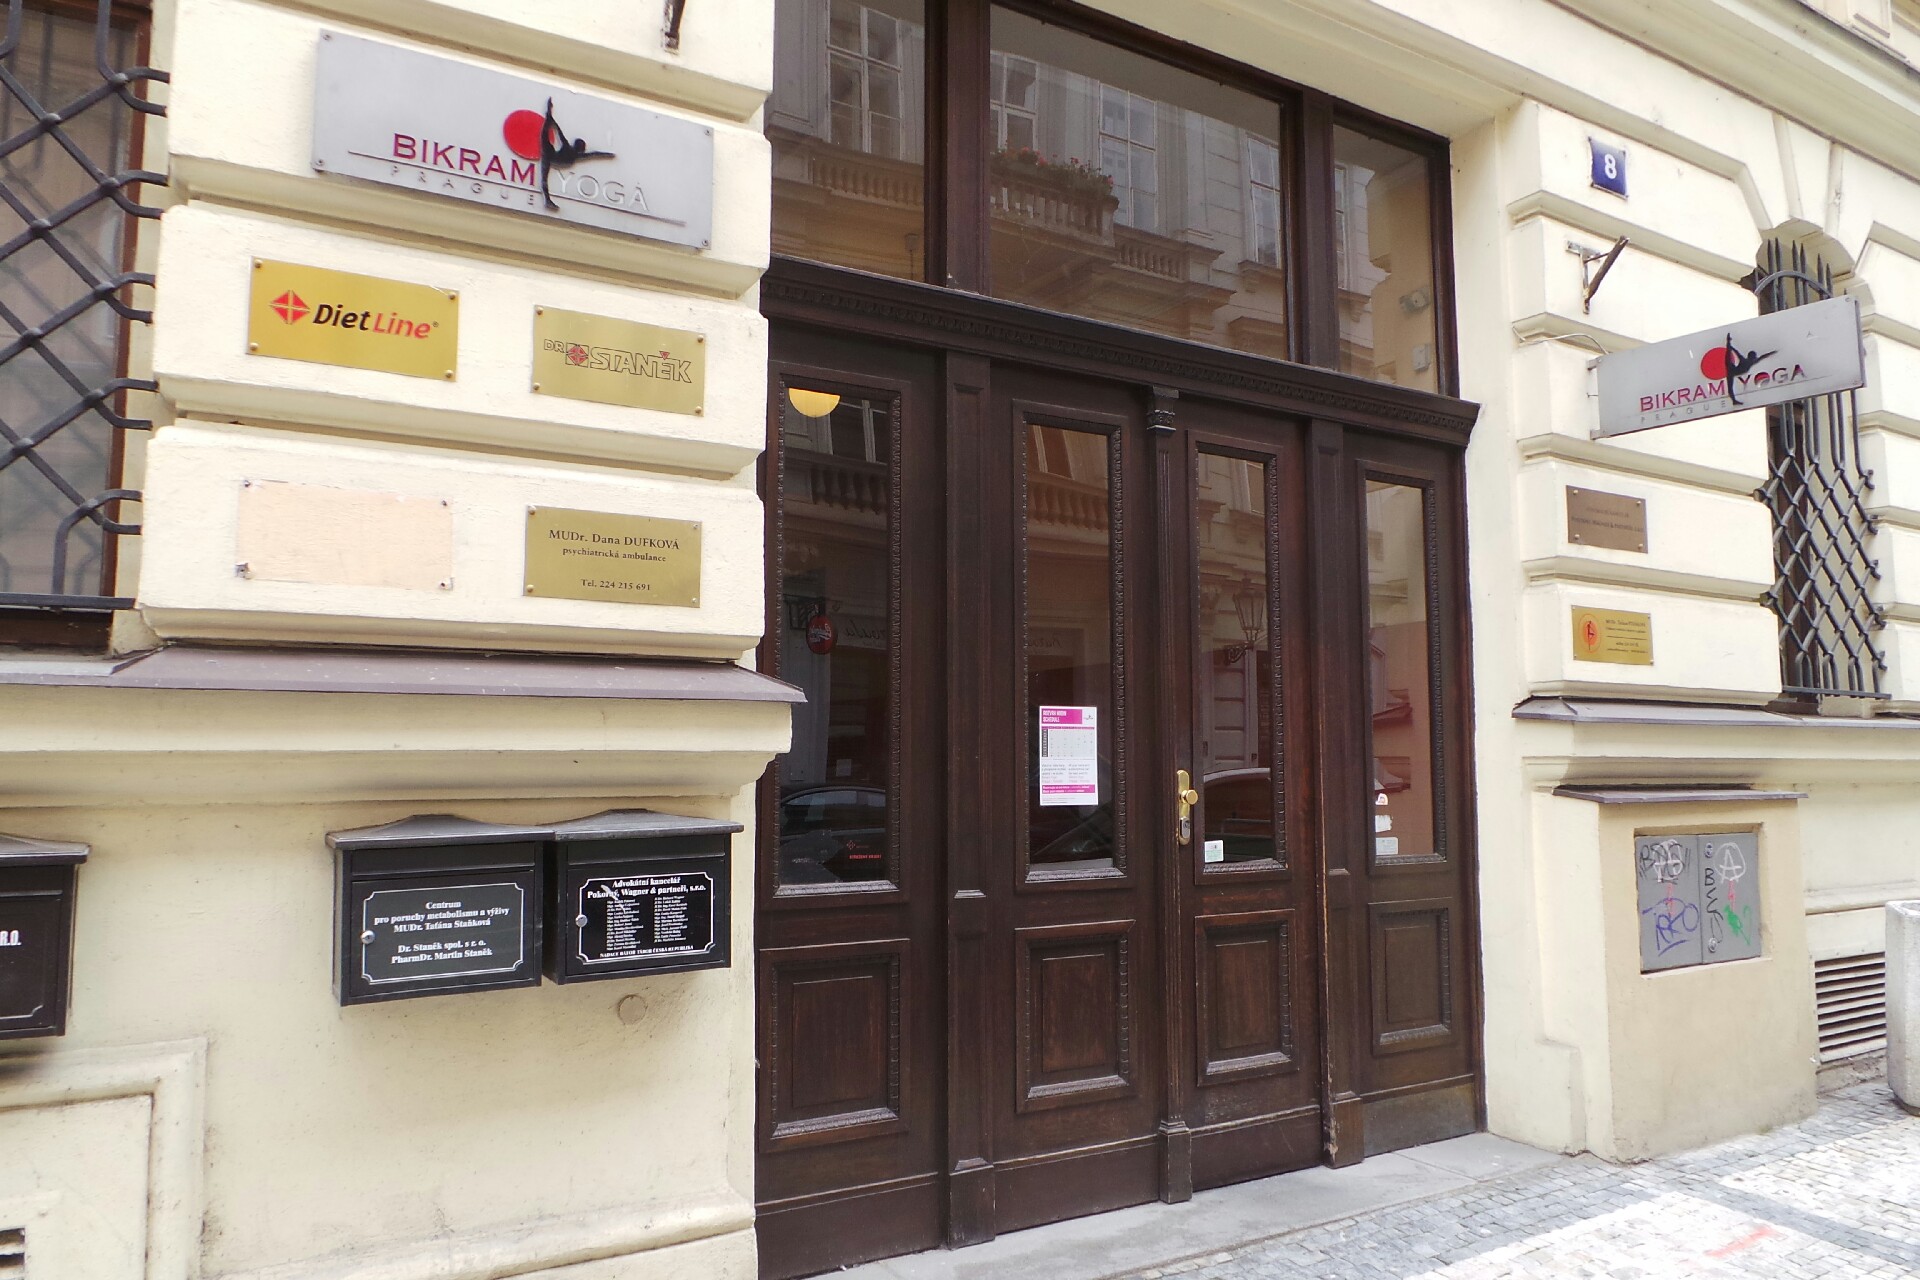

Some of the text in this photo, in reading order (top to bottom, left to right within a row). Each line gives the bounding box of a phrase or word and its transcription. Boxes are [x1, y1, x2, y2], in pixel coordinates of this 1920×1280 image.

[392, 133, 650, 212] BIKRAM YOGA
[1604, 153, 1617, 179] 8
[390, 164, 535, 206] PRAGUE
[590, 346, 692, 384] STANĚK
[1640, 363, 1808, 412] BIKRAM YOGA
[549, 529, 680, 550] MUDr. Dana DUFKOVÁ
[563, 547, 667, 562] psychiatrická ambulance
[581, 579, 650, 591] Tel. 224 215 691
[621, 888, 649, 897] Wagner
[650, 886, 656, 894] &
[426, 901, 462, 910] Centrum
[374, 916, 389, 925] pro
[391, 912, 425, 925] poruchy
[427, 909, 478, 920] metabolismu
[487, 907, 510, 917] výživy
[394, 923, 423, 932] MUDr.
[398, 945, 412, 953] Dr.
[413, 941, 443, 951] Staněk
[444, 940, 463, 951] spol.
[391, 948, 493, 964] PharmDr. Martin Staněk
